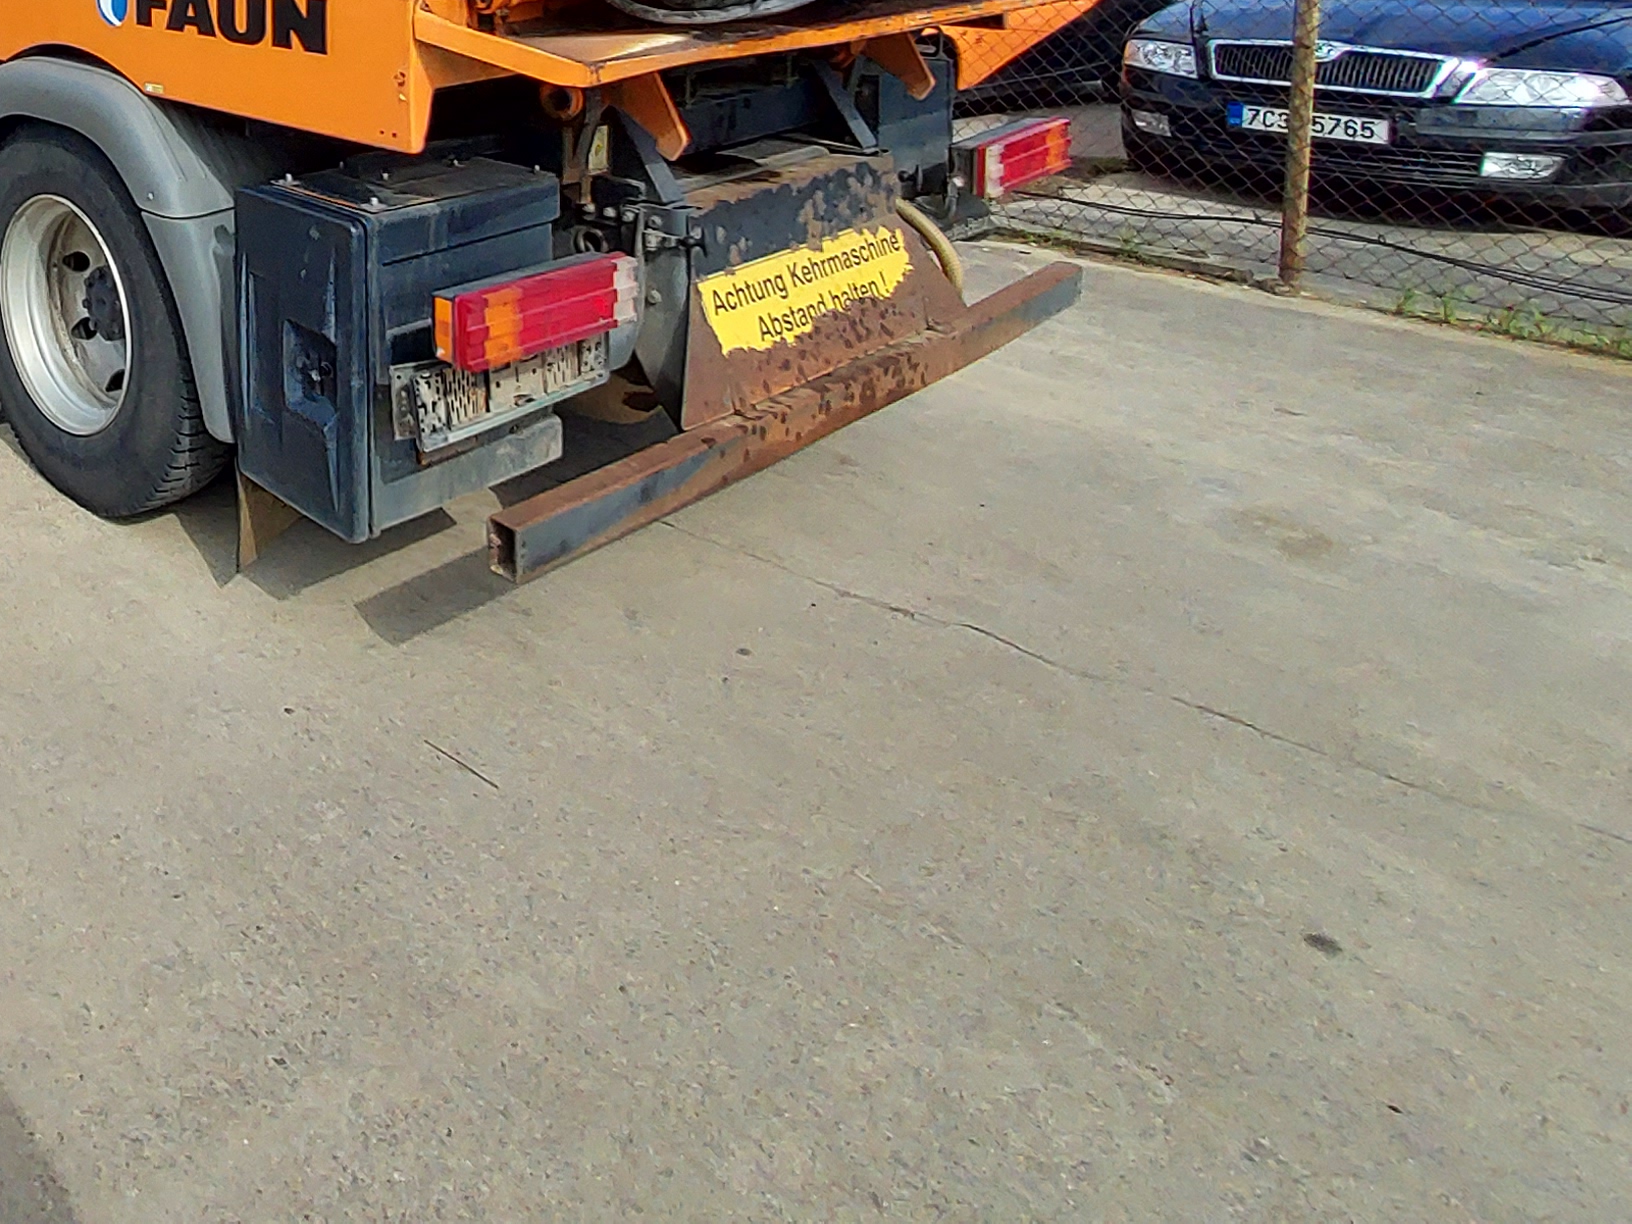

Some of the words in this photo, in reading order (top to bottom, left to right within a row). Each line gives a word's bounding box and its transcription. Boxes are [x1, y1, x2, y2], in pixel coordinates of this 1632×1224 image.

[712, 273, 787, 316] Achtung
[786, 232, 900, 288] Kehrmaschine
[758, 293, 828, 342] Abstand
